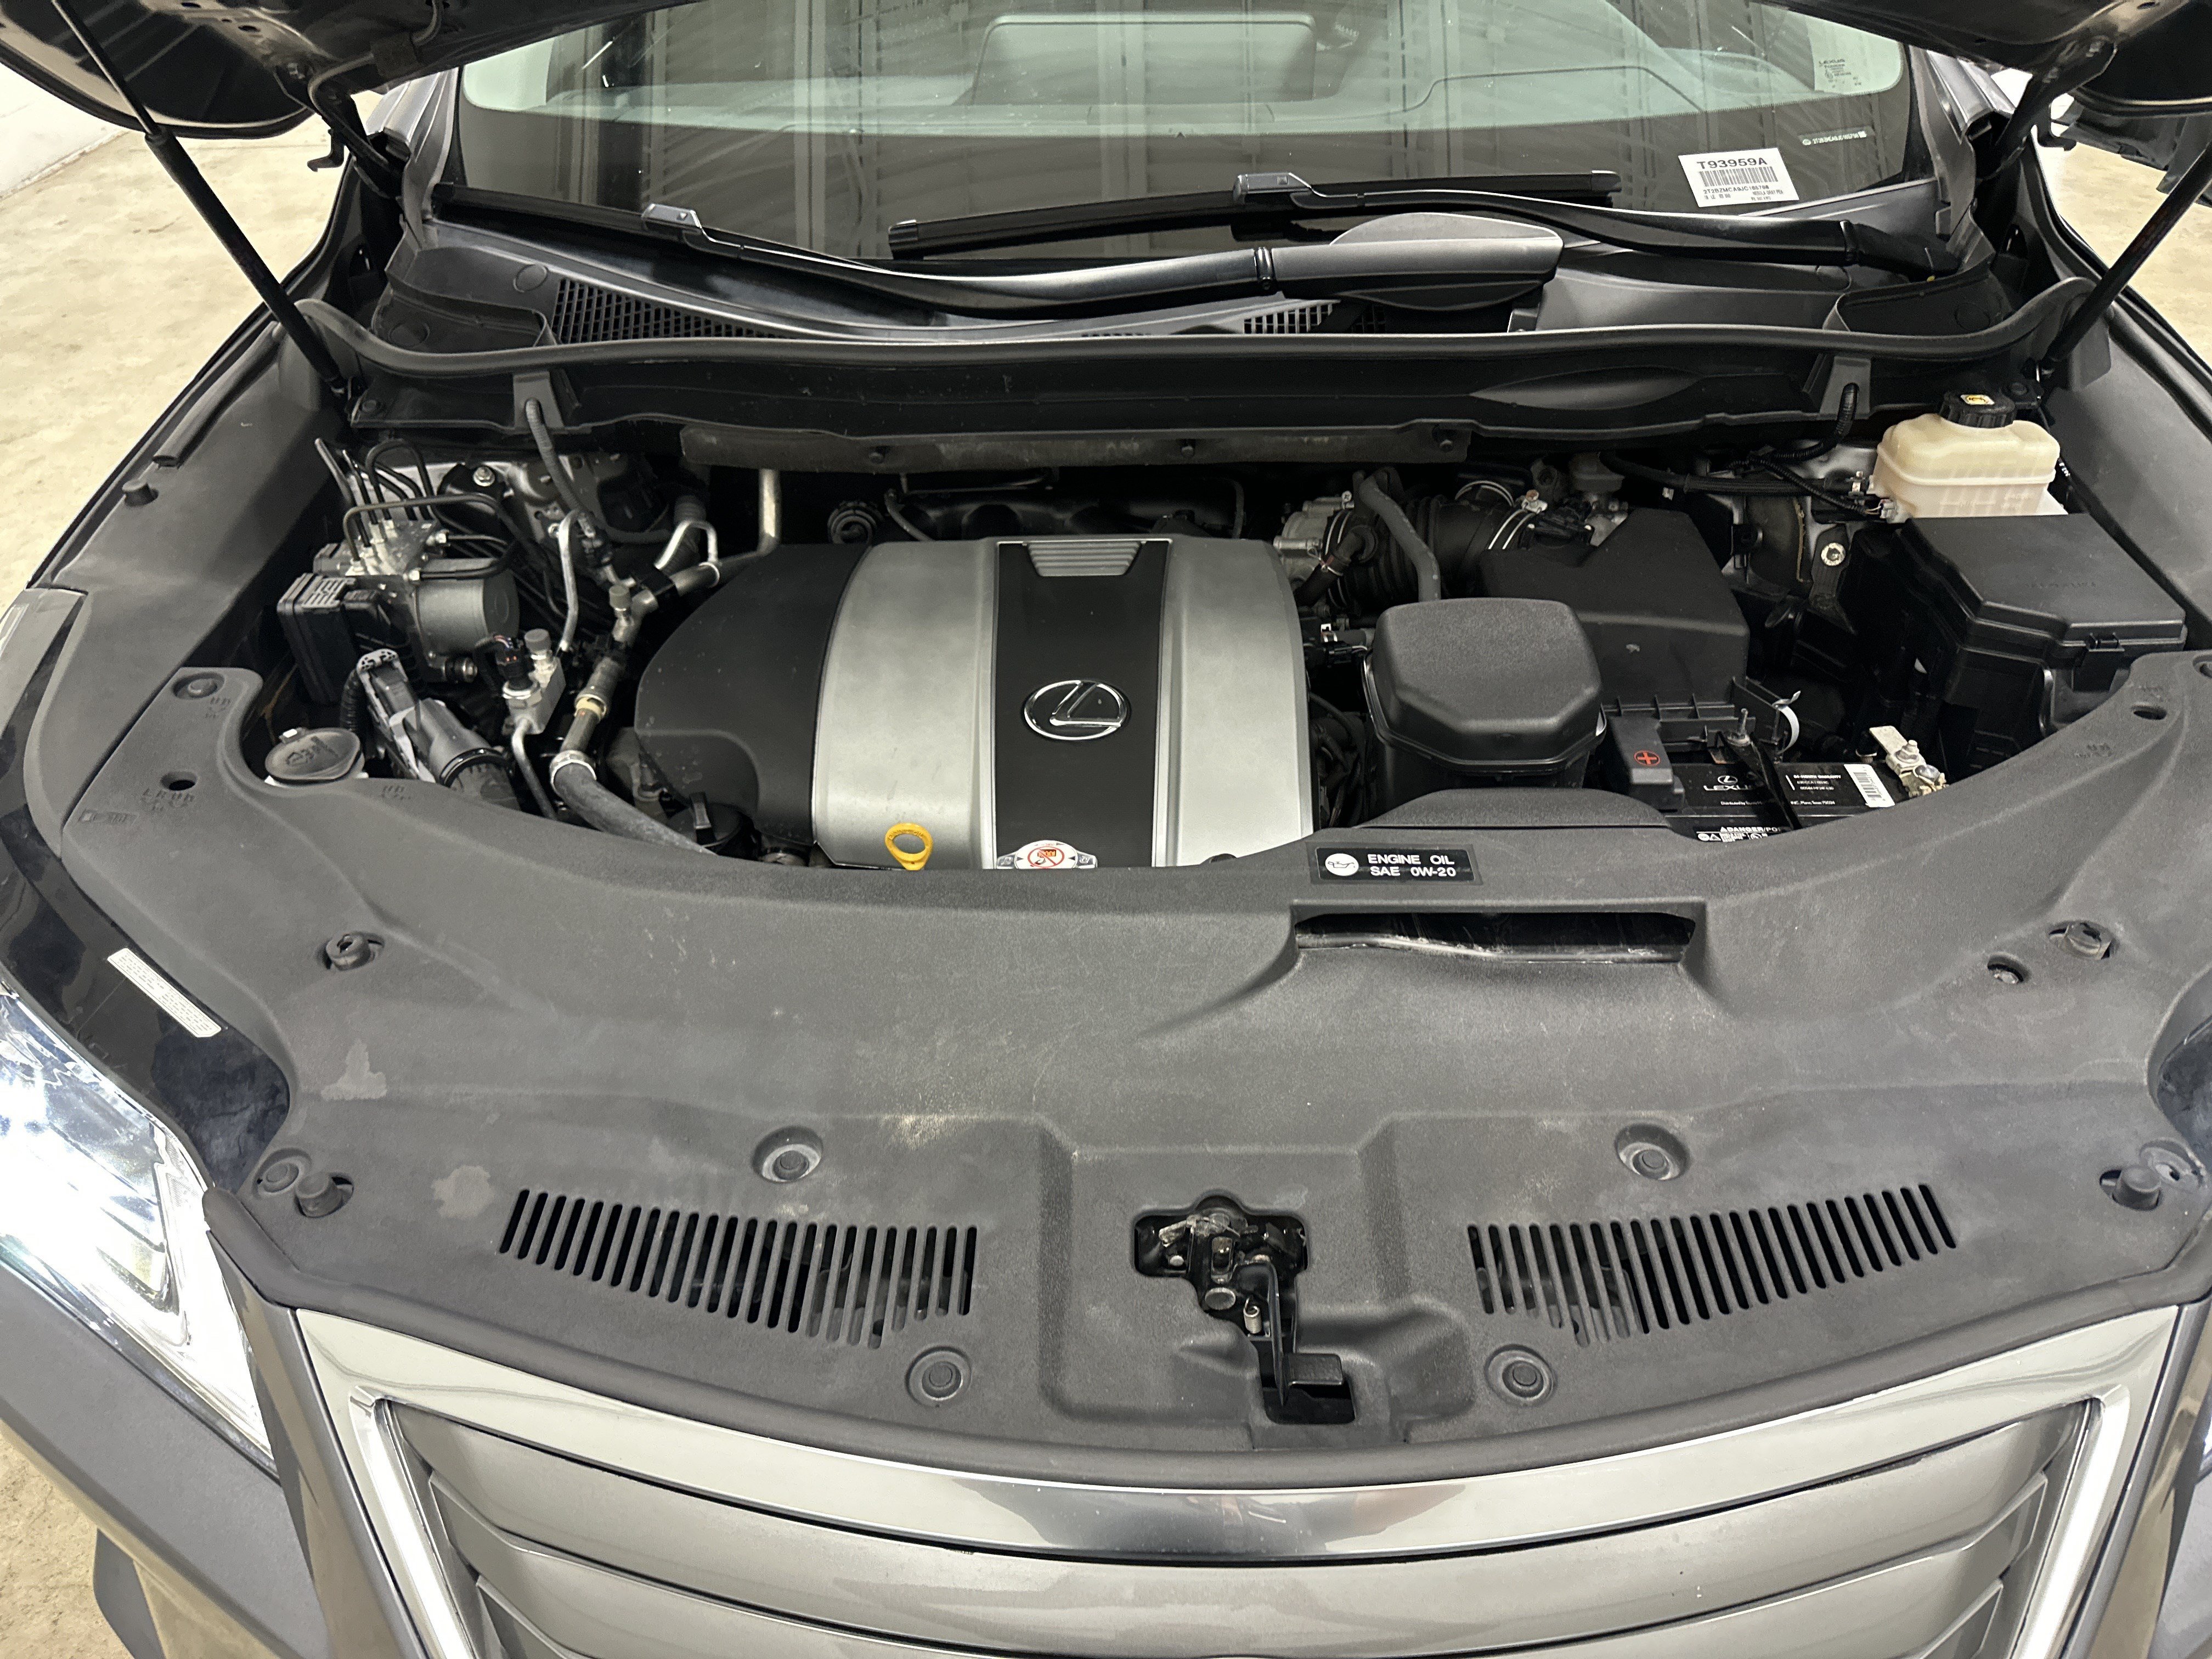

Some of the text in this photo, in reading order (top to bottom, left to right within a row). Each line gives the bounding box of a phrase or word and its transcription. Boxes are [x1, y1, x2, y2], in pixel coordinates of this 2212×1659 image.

[1696, 157, 1768, 170] T93959A
[1367, 854, 1455, 865] ENGINE OIL
[1370, 866, 1457, 877] SAE 0W-20
